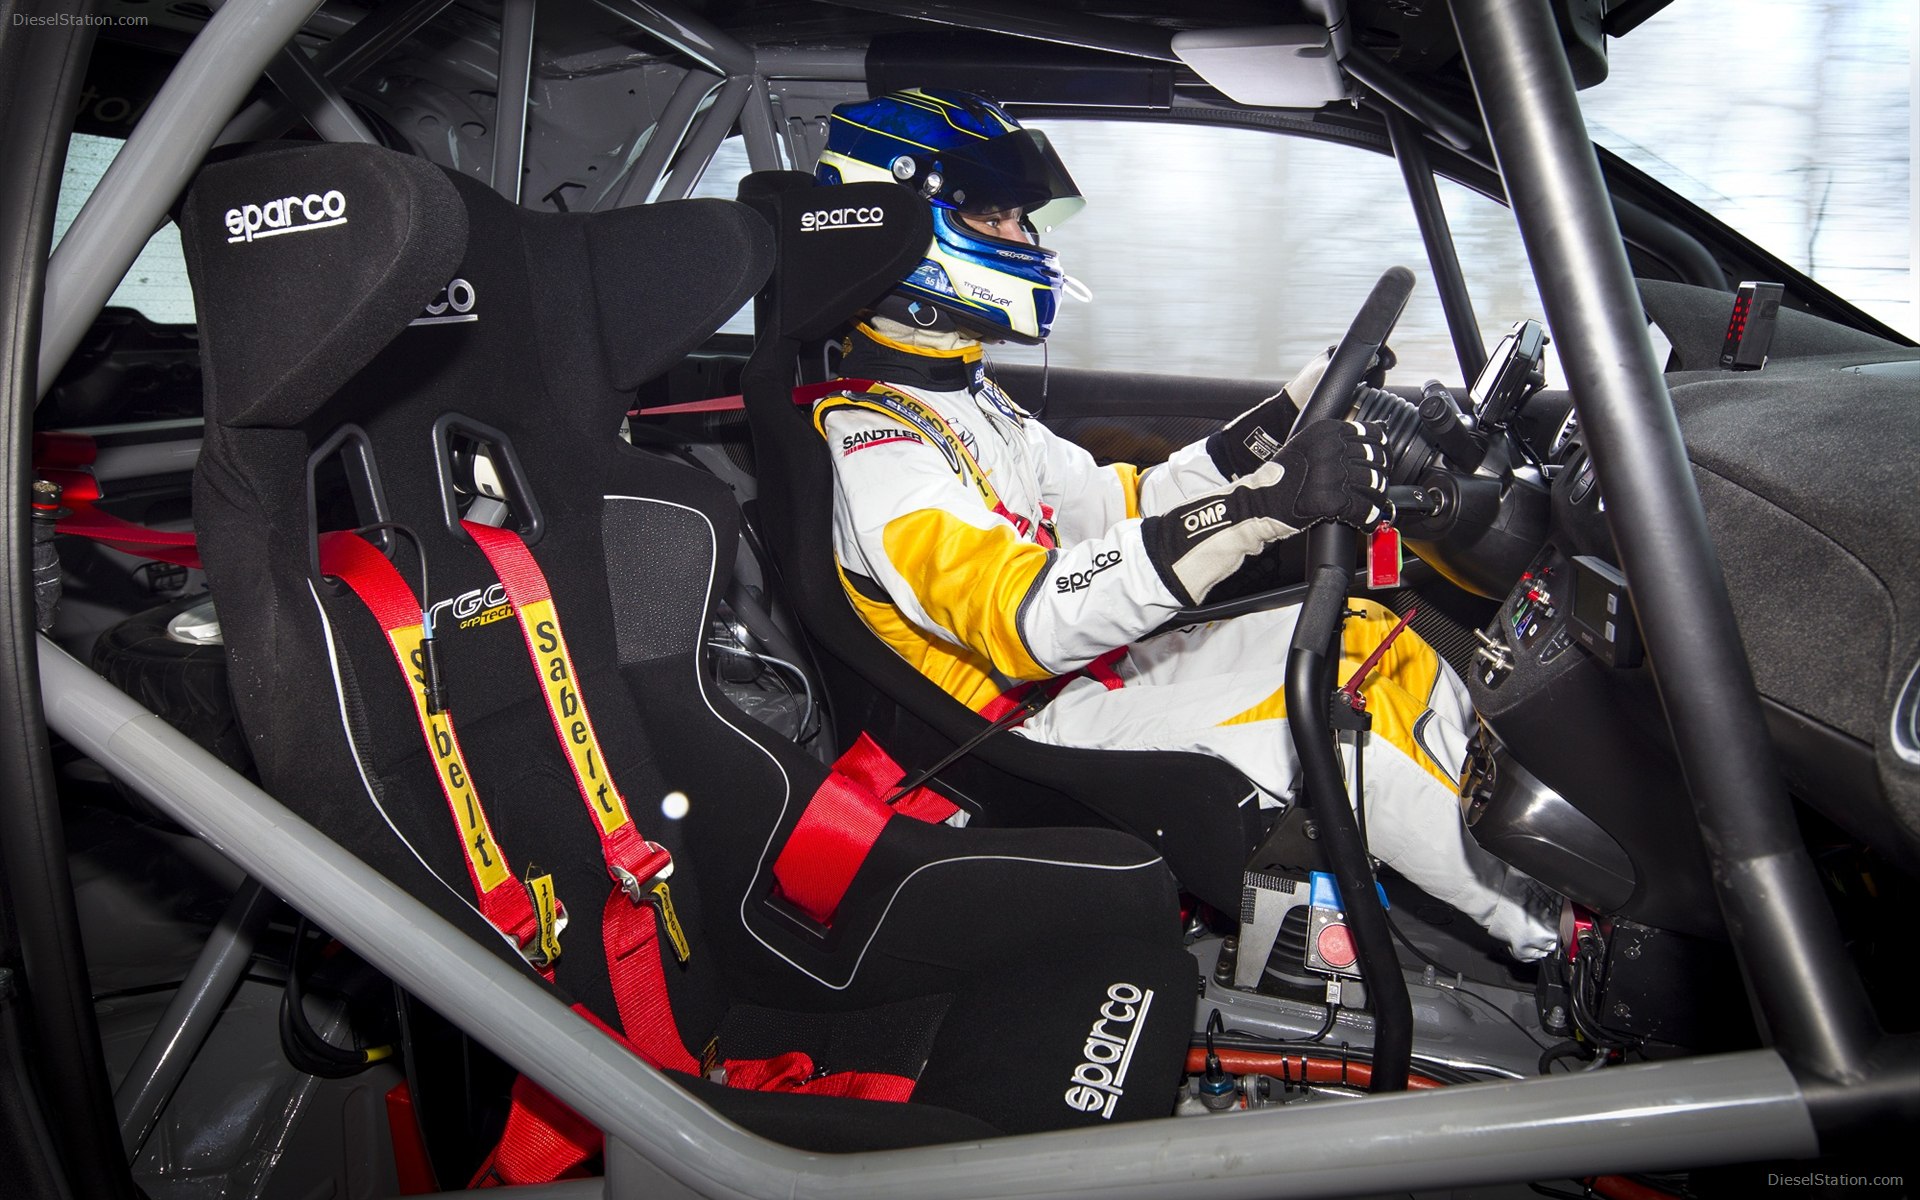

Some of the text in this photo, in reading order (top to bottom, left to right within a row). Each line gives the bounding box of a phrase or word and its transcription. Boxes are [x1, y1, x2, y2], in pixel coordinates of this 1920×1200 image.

[224, 189, 347, 243] sparco
[800, 206, 884, 232] sparco
[842, 428, 923, 451] SANDTLER
[1184, 502, 1228, 533] OMP
[1056, 550, 1123, 594] spaco
[535, 620, 614, 815] Sabelt
[410, 647, 492, 868] Sbelt
[540, 883, 559, 959] Sabelt
[1064, 982, 1153, 1118] sparco
